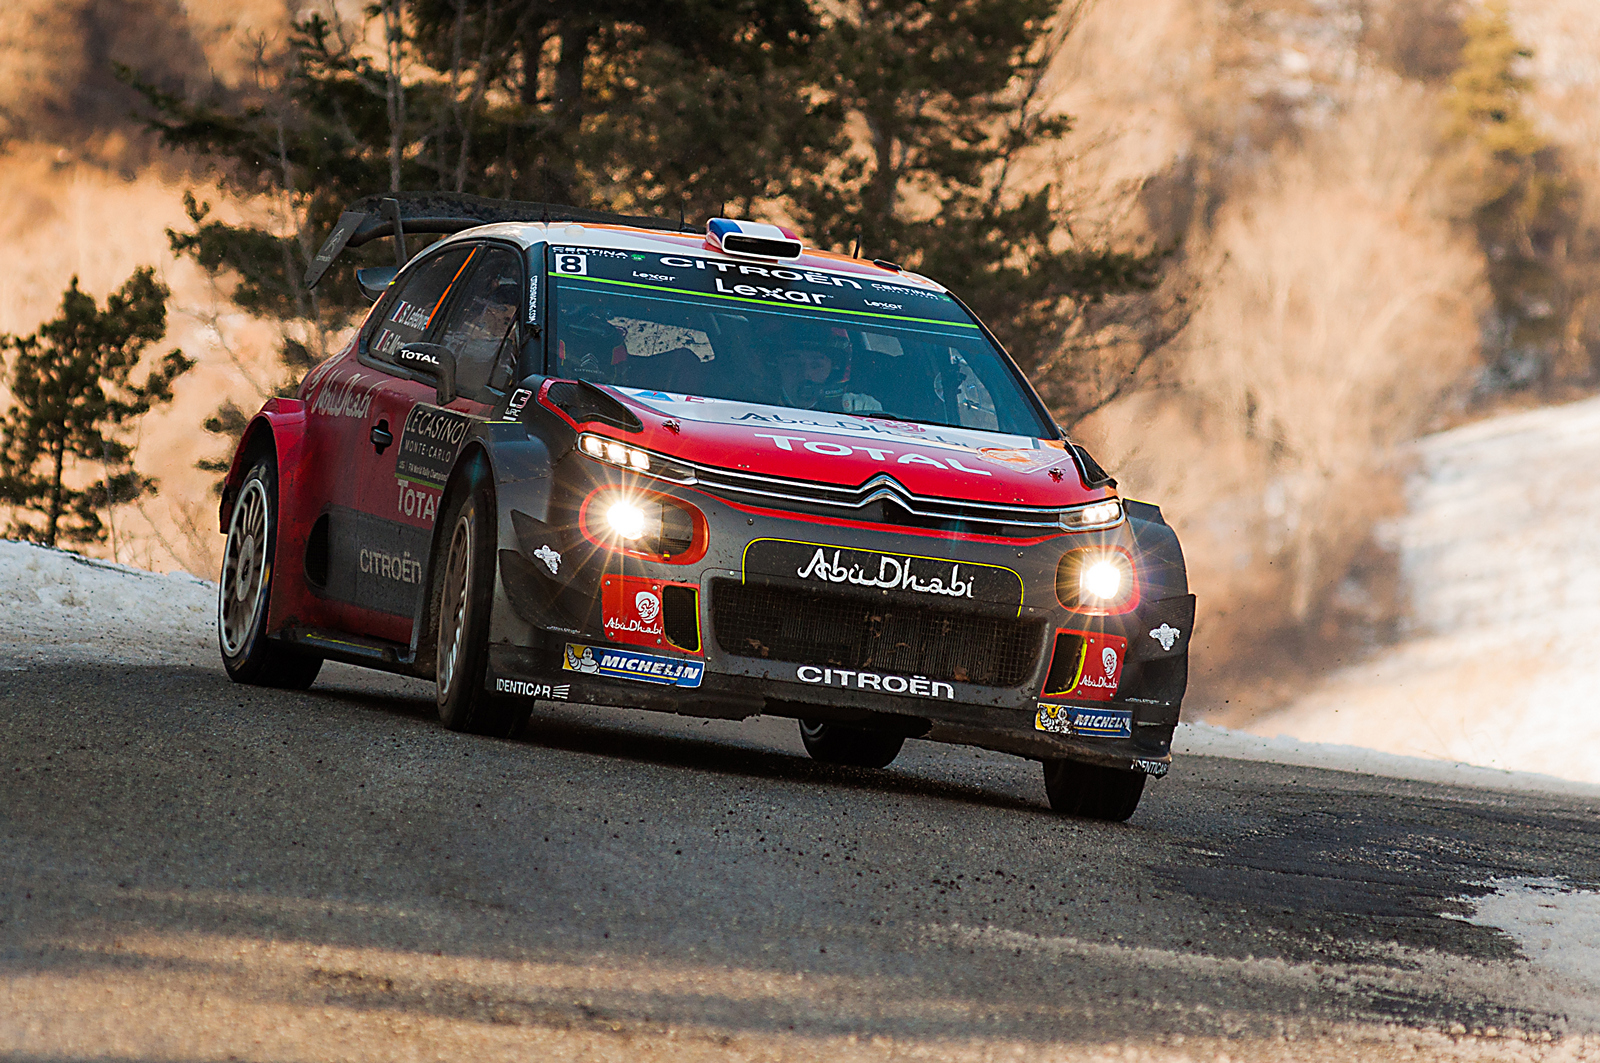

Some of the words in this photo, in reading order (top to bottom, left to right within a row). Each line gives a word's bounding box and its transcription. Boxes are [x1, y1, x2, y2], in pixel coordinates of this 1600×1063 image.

[560, 255, 582, 273] 8
[632, 270, 676, 282] Lexar
[659, 256, 863, 290] CITROËN
[715, 277, 828, 305] Lexar
[871, 283, 939, 300] CERTINA
[863, 298, 903, 310] Lexar
[401, 349, 440, 365] TOTAL
[406, 409, 422, 433] LE
[418, 413, 465, 445] CASINO
[753, 433, 992, 476] TOTAL
[359, 548, 422, 585] CITROËN
[797, 547, 878, 586] Abu
[876, 555, 975, 598] Dhabi
[604, 616, 632, 632] Abu
[629, 618, 664, 636] Dhabi
[601, 654, 700, 680] MICHELIN
[496, 678, 551, 700] IDENTICAR
[796, 665, 955, 699] CITROËN
[1079, 674, 1098, 688] Abu
